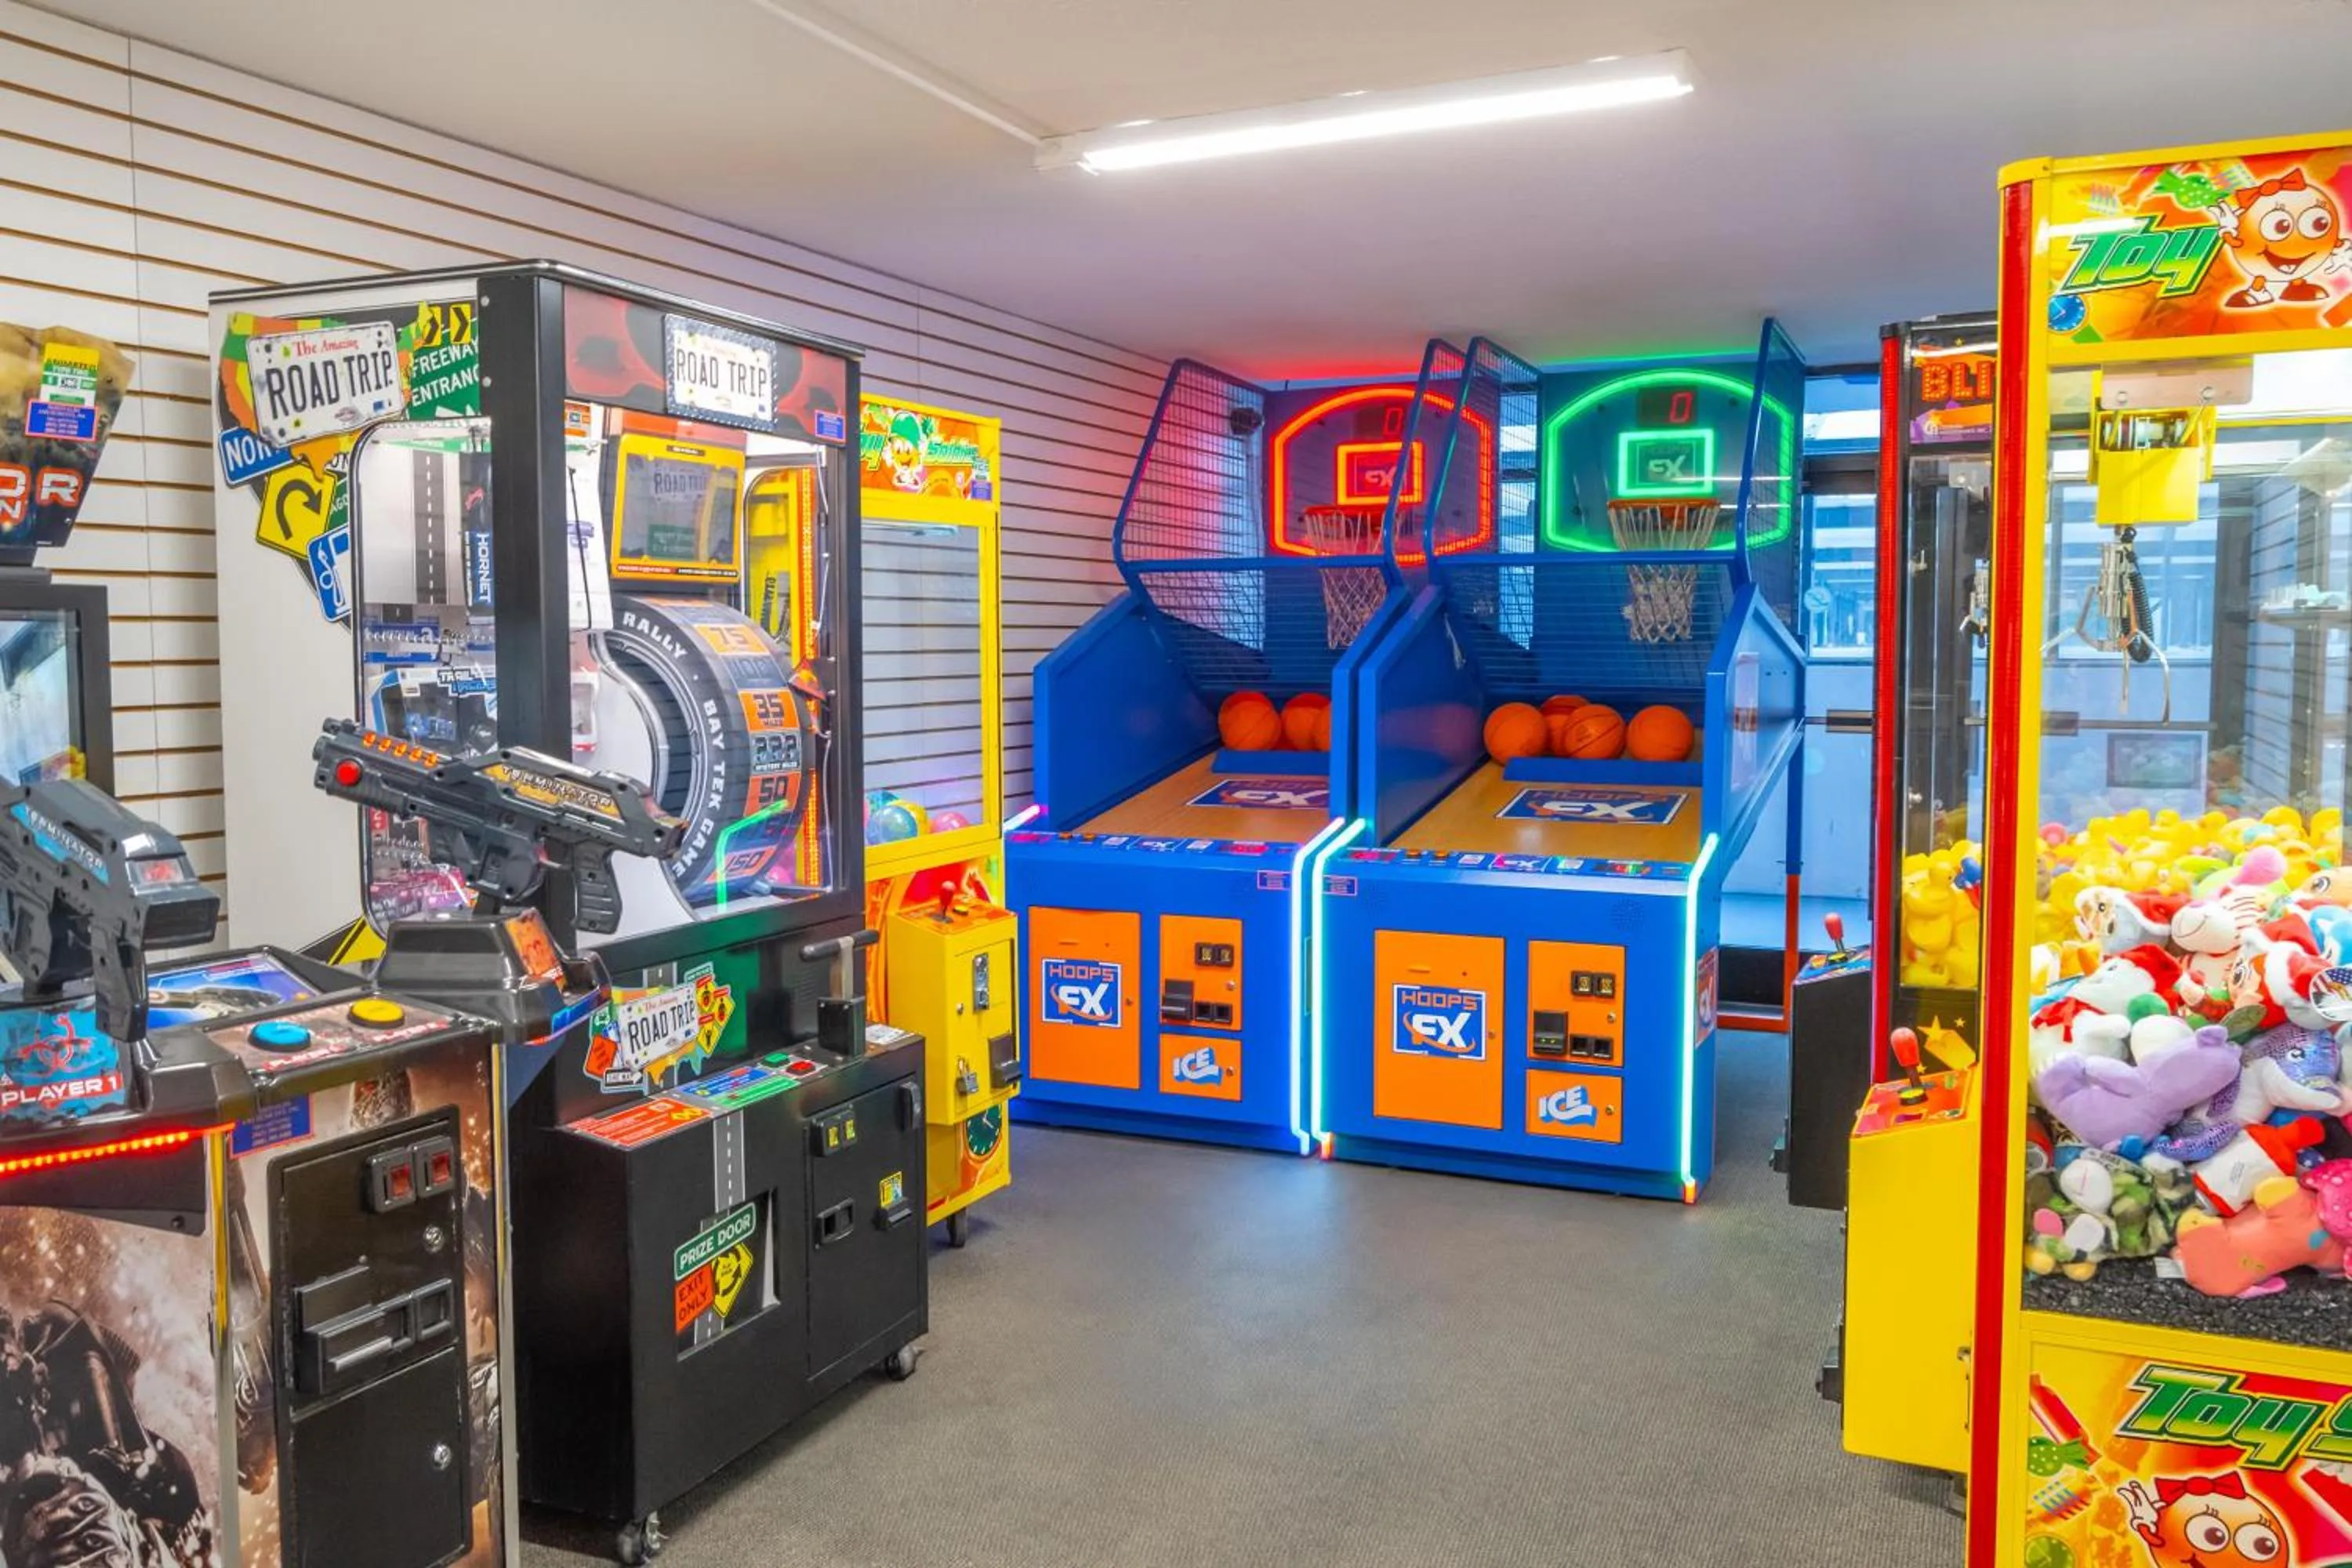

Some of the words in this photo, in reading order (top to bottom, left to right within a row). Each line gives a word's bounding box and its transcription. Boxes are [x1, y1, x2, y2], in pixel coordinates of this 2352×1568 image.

[2059, 215, 2222, 296] Toy
[295, 339, 318, 357] The
[412, 336, 478, 377] FREEWAY
[265, 359, 340, 419] ROAD
[343, 350, 393, 397] TRIP
[677, 350, 719, 389] ROAD
[728, 359, 767, 398] TRIP
[1669, 390, 1693, 423] 0
[476, 532, 492, 603] HORNET
[622, 611, 688, 660] RALLY
[709, 627, 751, 645] 75
[753, 693, 784, 719] 35
[703, 699, 724, 750] BAY
[708, 761, 726, 811] TEK
[758, 777, 787, 804] 50
[1049, 965, 1117, 982] HOOPS
[1401, 991, 1482, 1011] HOOPS
[627, 1010, 669, 1054] ROAD
[670, 1000, 696, 1032] TRIP
[1173, 1047, 1220, 1081] ICE
[0, 1078, 103, 1106] PLAYER
[108, 1076, 118, 1091] 1
[1538, 1087, 1593, 1122] ICE
[680, 1236, 714, 1270] PRIZE
[717, 1214, 751, 1245] DOOR
[679, 1271, 704, 1302] EXIT
[678, 1288, 709, 1322] ONLY
[2120, 1362, 2322, 1471] Toy
